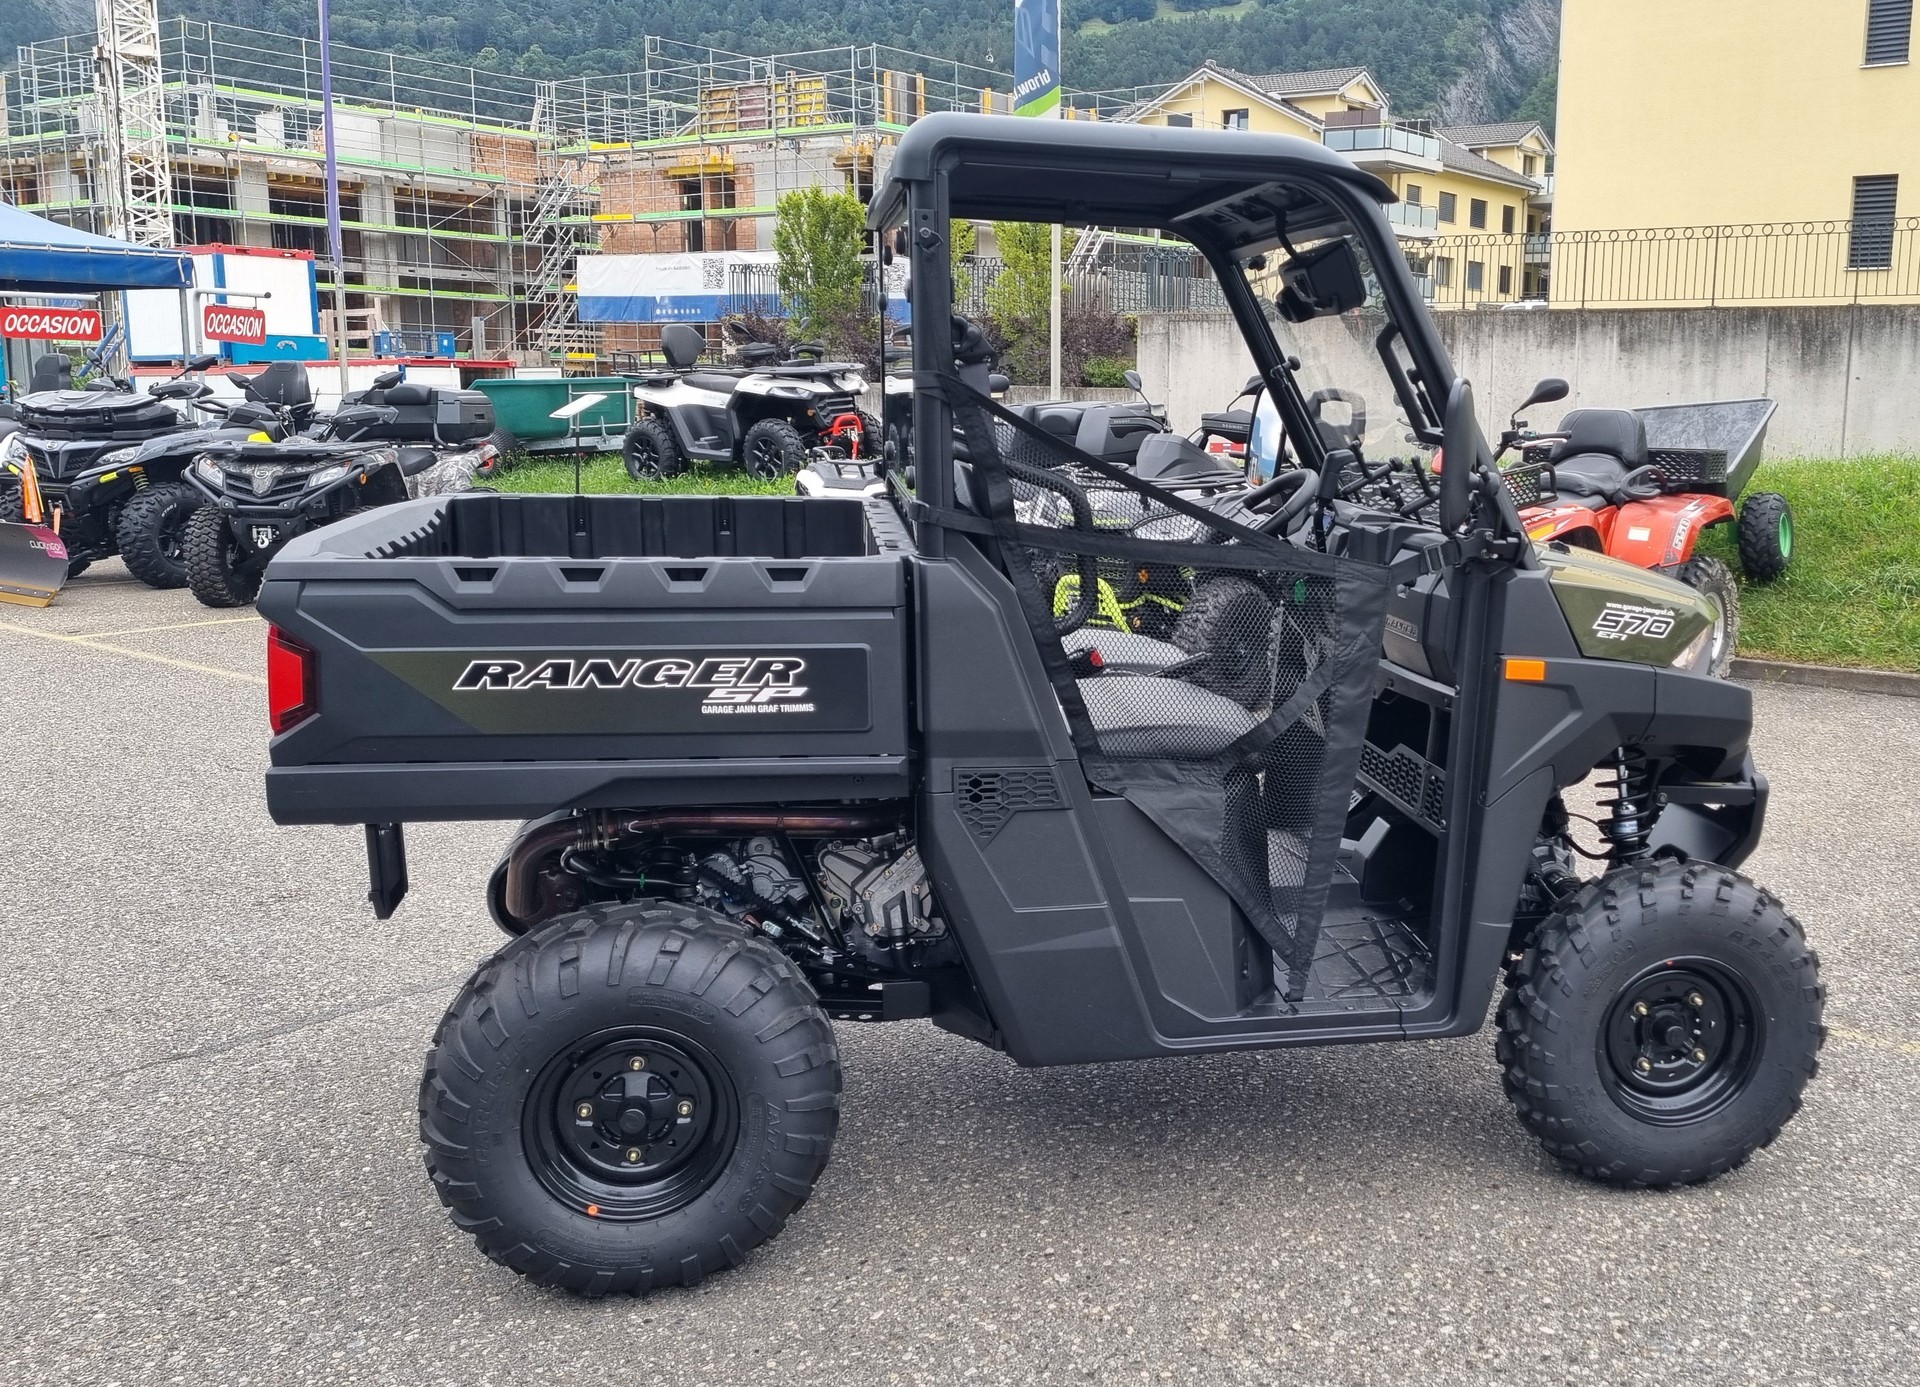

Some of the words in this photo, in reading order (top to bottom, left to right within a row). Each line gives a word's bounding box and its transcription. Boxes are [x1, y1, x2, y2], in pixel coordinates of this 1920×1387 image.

[4, 313, 96, 335] OCCASION
[207, 313, 263, 338] OCCASION
[1592, 609, 1675, 638] 570
[1596, 630, 1628, 641] EFI
[452, 657, 805, 690] RANGER
[702, 687, 808, 703] SP
[701, 705, 734, 714] GARAGE
[735, 705, 756, 713] JANN
[757, 704, 779, 713] GRAF
[779, 703, 814, 712] TRIMMIS
